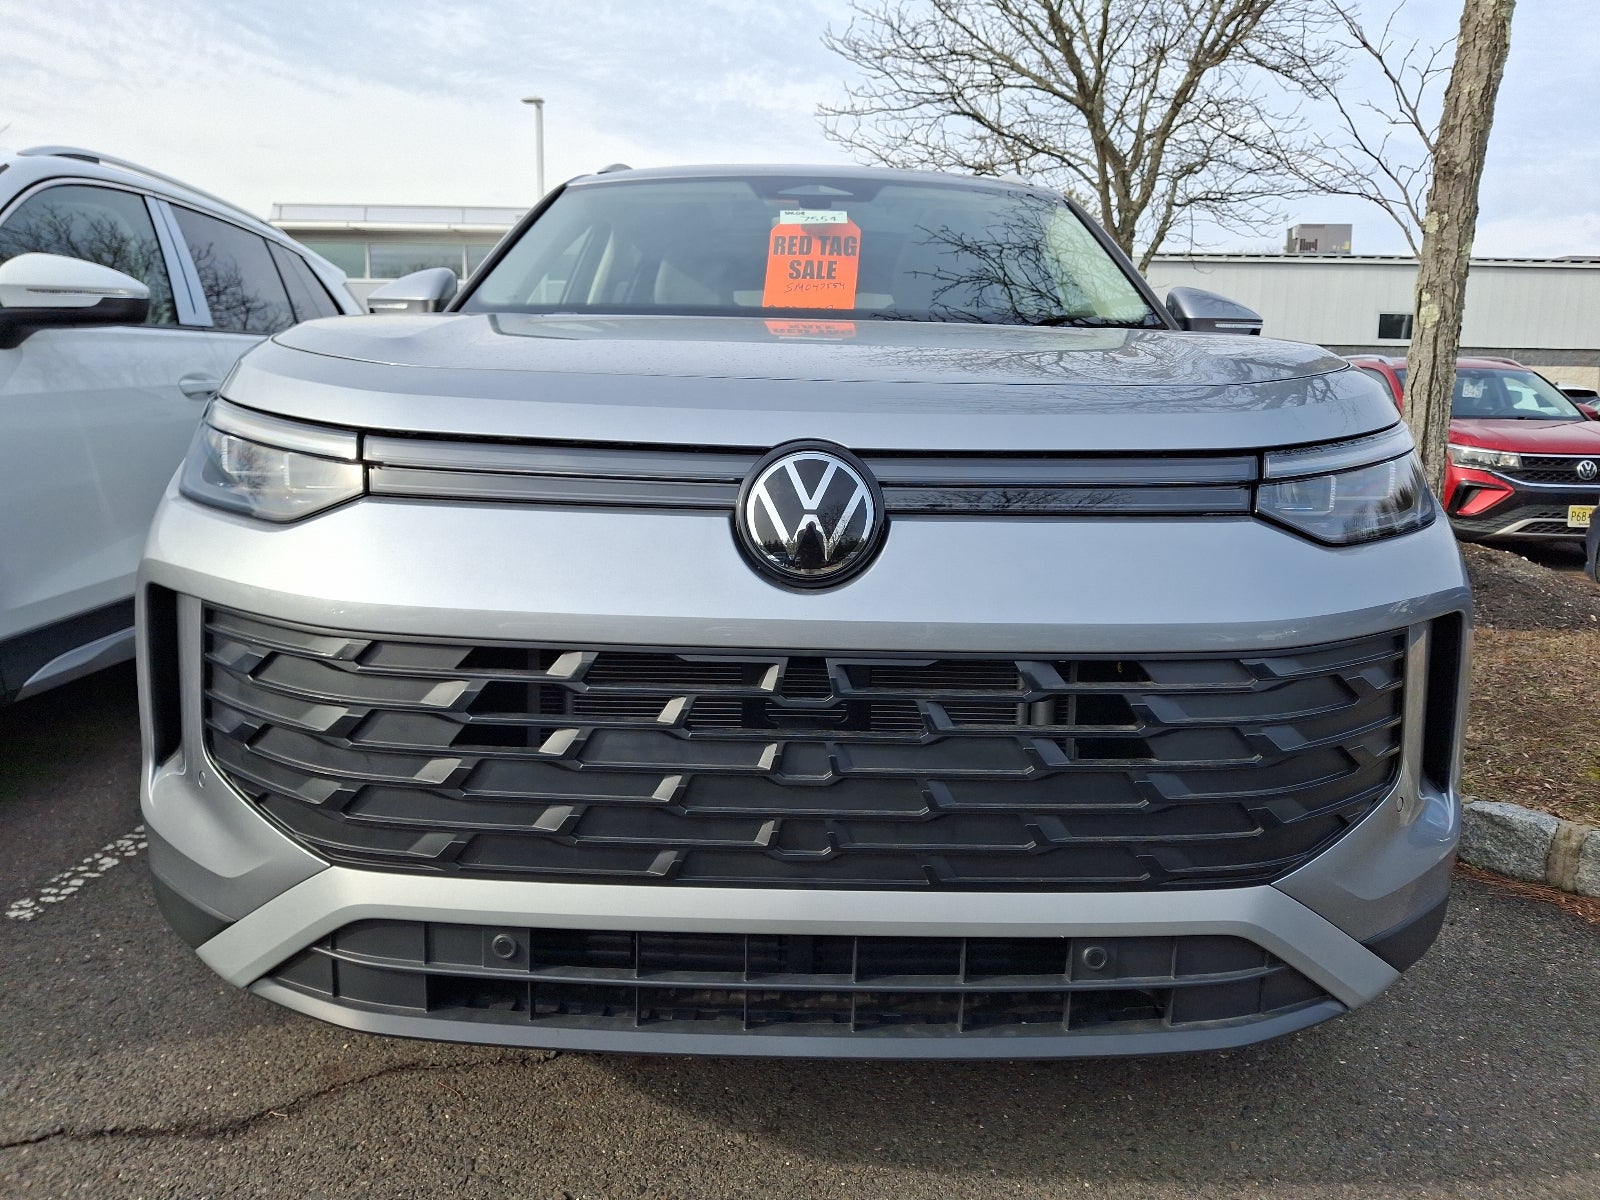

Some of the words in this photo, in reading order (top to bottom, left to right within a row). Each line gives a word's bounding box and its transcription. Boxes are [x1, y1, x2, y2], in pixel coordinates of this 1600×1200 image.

[773, 235, 812, 256] RED
[819, 235, 857, 257] TAG
[788, 260, 838, 280] SALE
